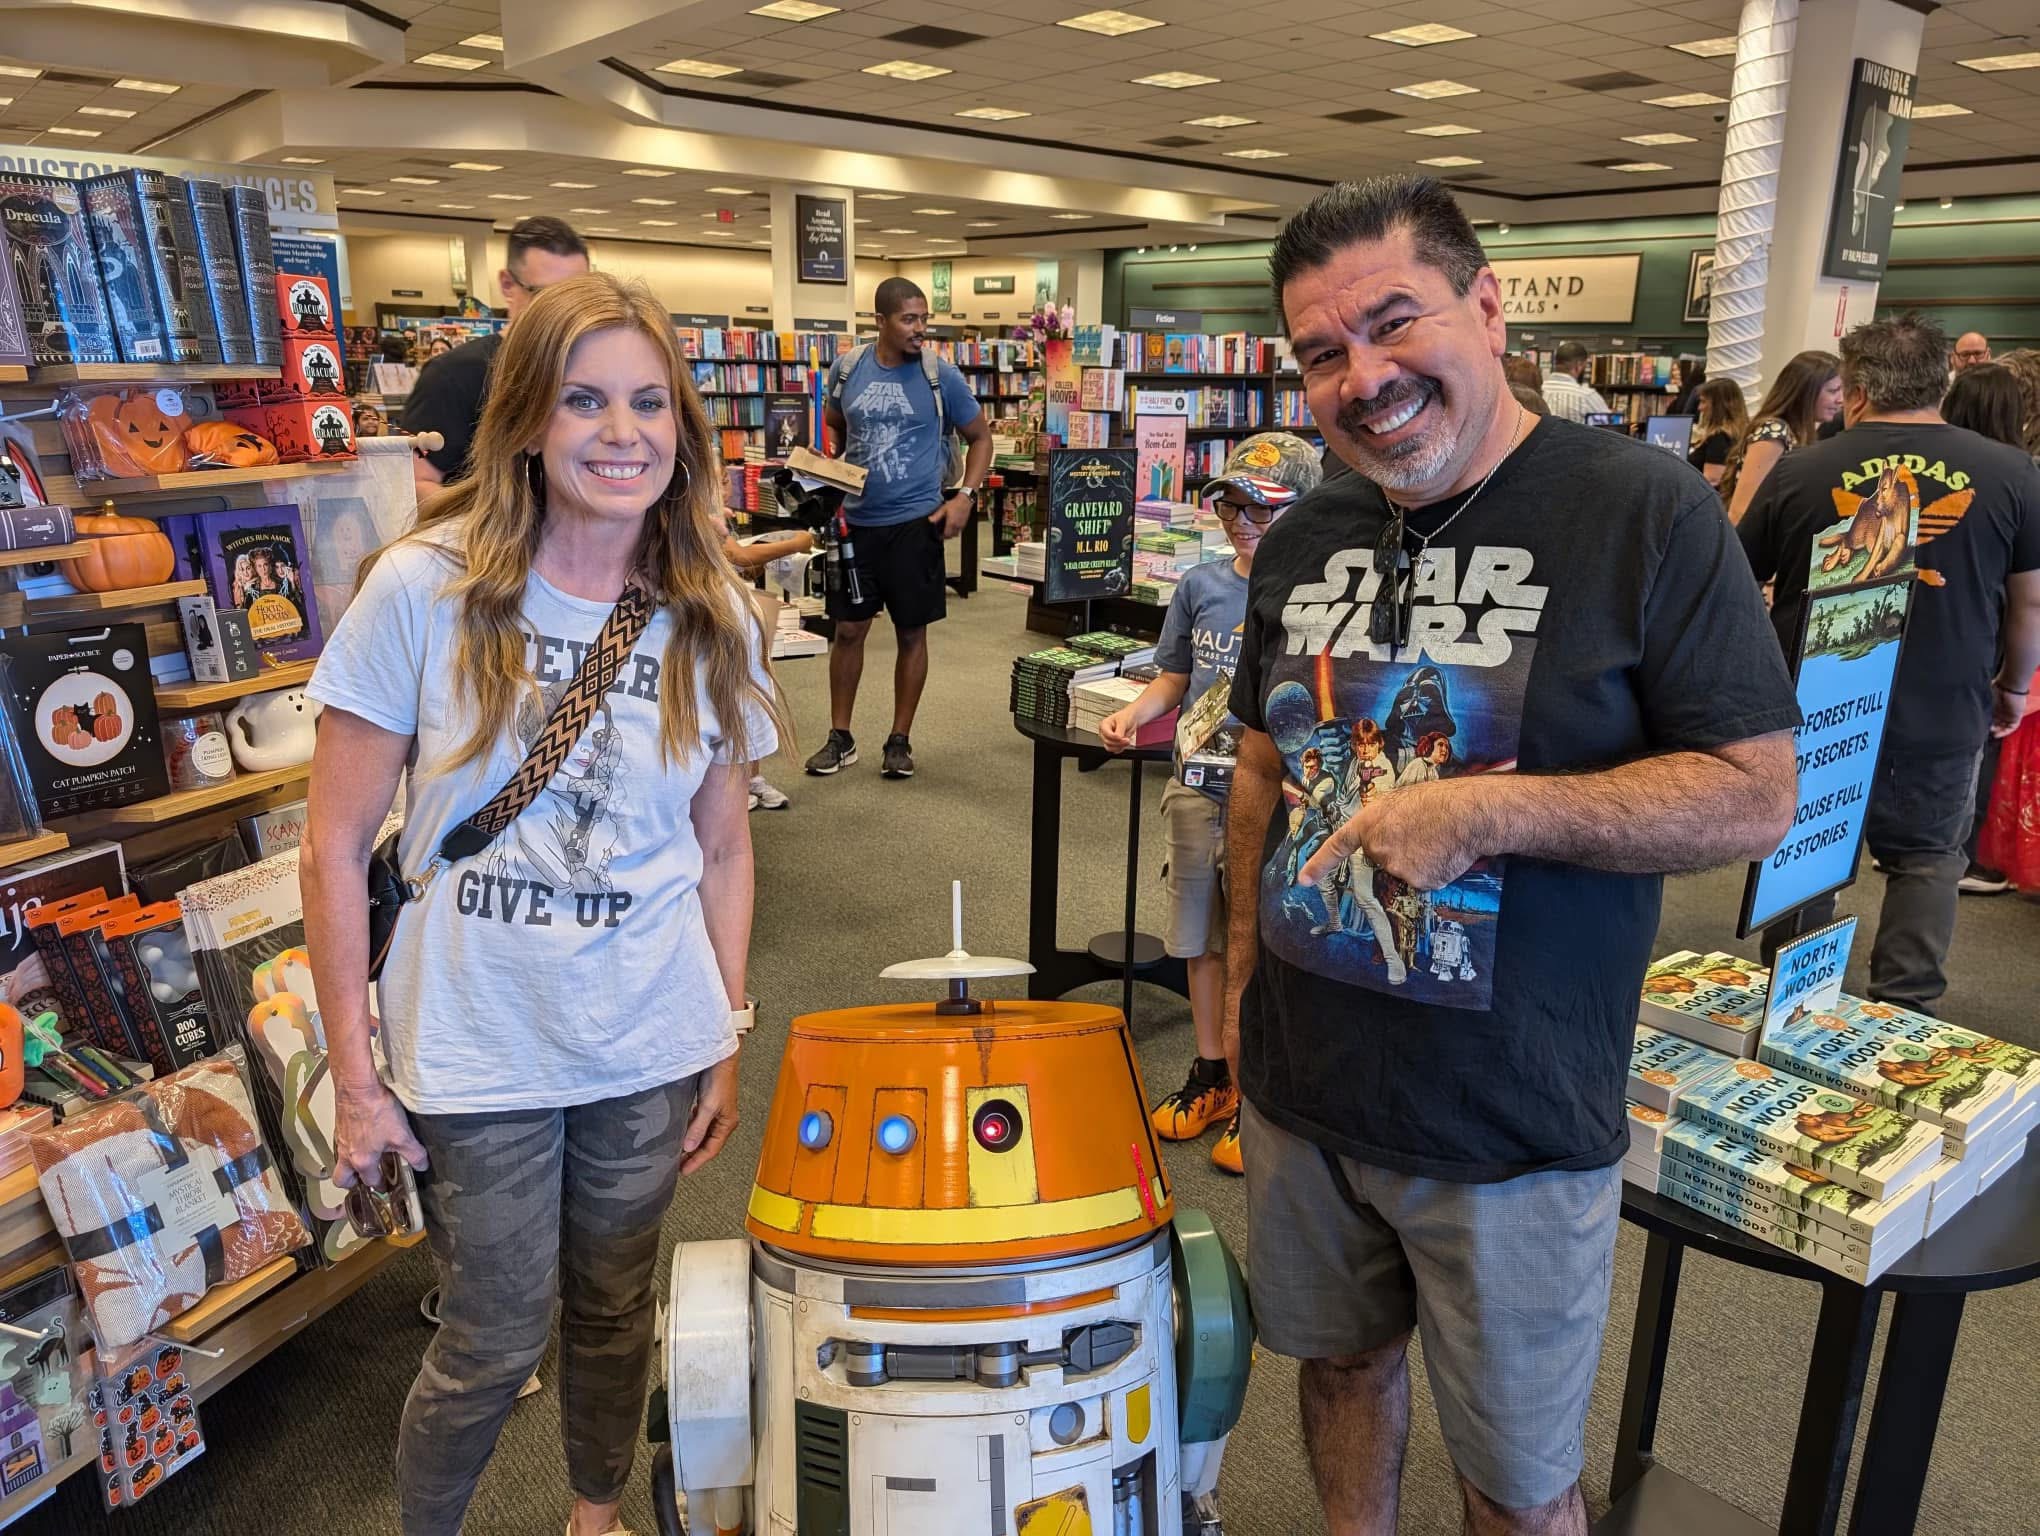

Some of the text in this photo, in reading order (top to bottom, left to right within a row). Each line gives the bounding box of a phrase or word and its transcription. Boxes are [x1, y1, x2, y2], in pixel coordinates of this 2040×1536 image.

[1862, 60, 1911, 95] INVISIBLE
[1888, 94, 1913, 119] MAN
[5, 208, 61, 224] Dracula
[1498, 276, 1585, 297] TAND
[292, 302, 328, 316] DRACULA
[1155, 313, 1175, 324] Fiction
[304, 365, 339, 379] DRACULA
[1055, 381, 1073, 389] COLLEEN
[1050, 390, 1078, 404] HOOVER
[315, 426, 349, 440] DRACULA
[1842, 454, 1970, 491] ADIDAS
[1064, 501, 1123, 518] GRAVEYARD
[1079, 519, 1109, 536] SHIFT
[225, 533, 292, 552] WITCHES RUN AMOK
[1094, 540, 1109, 553] RIO
[1287, 546, 1550, 610] STAR
[1282, 603, 1542, 668] WARS
[48, 650, 101, 662] PAPER SOURCE
[524, 632, 661, 702] EVR
[1804, 701, 1855, 736] FOREST
[1855, 691, 1883, 720] FULL
[1796, 730, 1869, 776] OF SECRETS.
[52, 778, 71, 789] CAT
[72, 770, 110, 785] PUMPKIN
[110, 765, 136, 779] PATCH
[1835, 781, 1863, 810] FULL
[266, 820, 301, 841] SCARY
[1773, 820, 1849, 869] OF STORIES.
[457, 869, 633, 928] GIVE UP
[1791, 939, 1839, 975] NORTH
[1785, 962, 1835, 1000] WOODS
[1675, 985, 1731, 1012] WOODS
[175, 1027, 206, 1046] CUBES
[176, 1018, 196, 1034] BOO
[1809, 1026, 1865, 1060] NORTH
[1630, 1043, 1691, 1073] NORTH
[1784, 1058, 1868, 1097] NORTH WOODS
[1710, 1084, 1735, 1102] DANIEL
[1725, 1076, 1789, 1114] NORTH
[1750, 1085, 1817, 1126] WOODS
[1700, 1114, 1738, 1135] NORTH
[1741, 1130, 1784, 1154] WOODS
[1687, 1151, 1725, 1173] NORTH
[1729, 1169, 1772, 1194] WOODS
[1685, 1171, 1769, 1214] NORTH WOODS
[1682, 1191, 1767, 1234] NORTH WOODS
